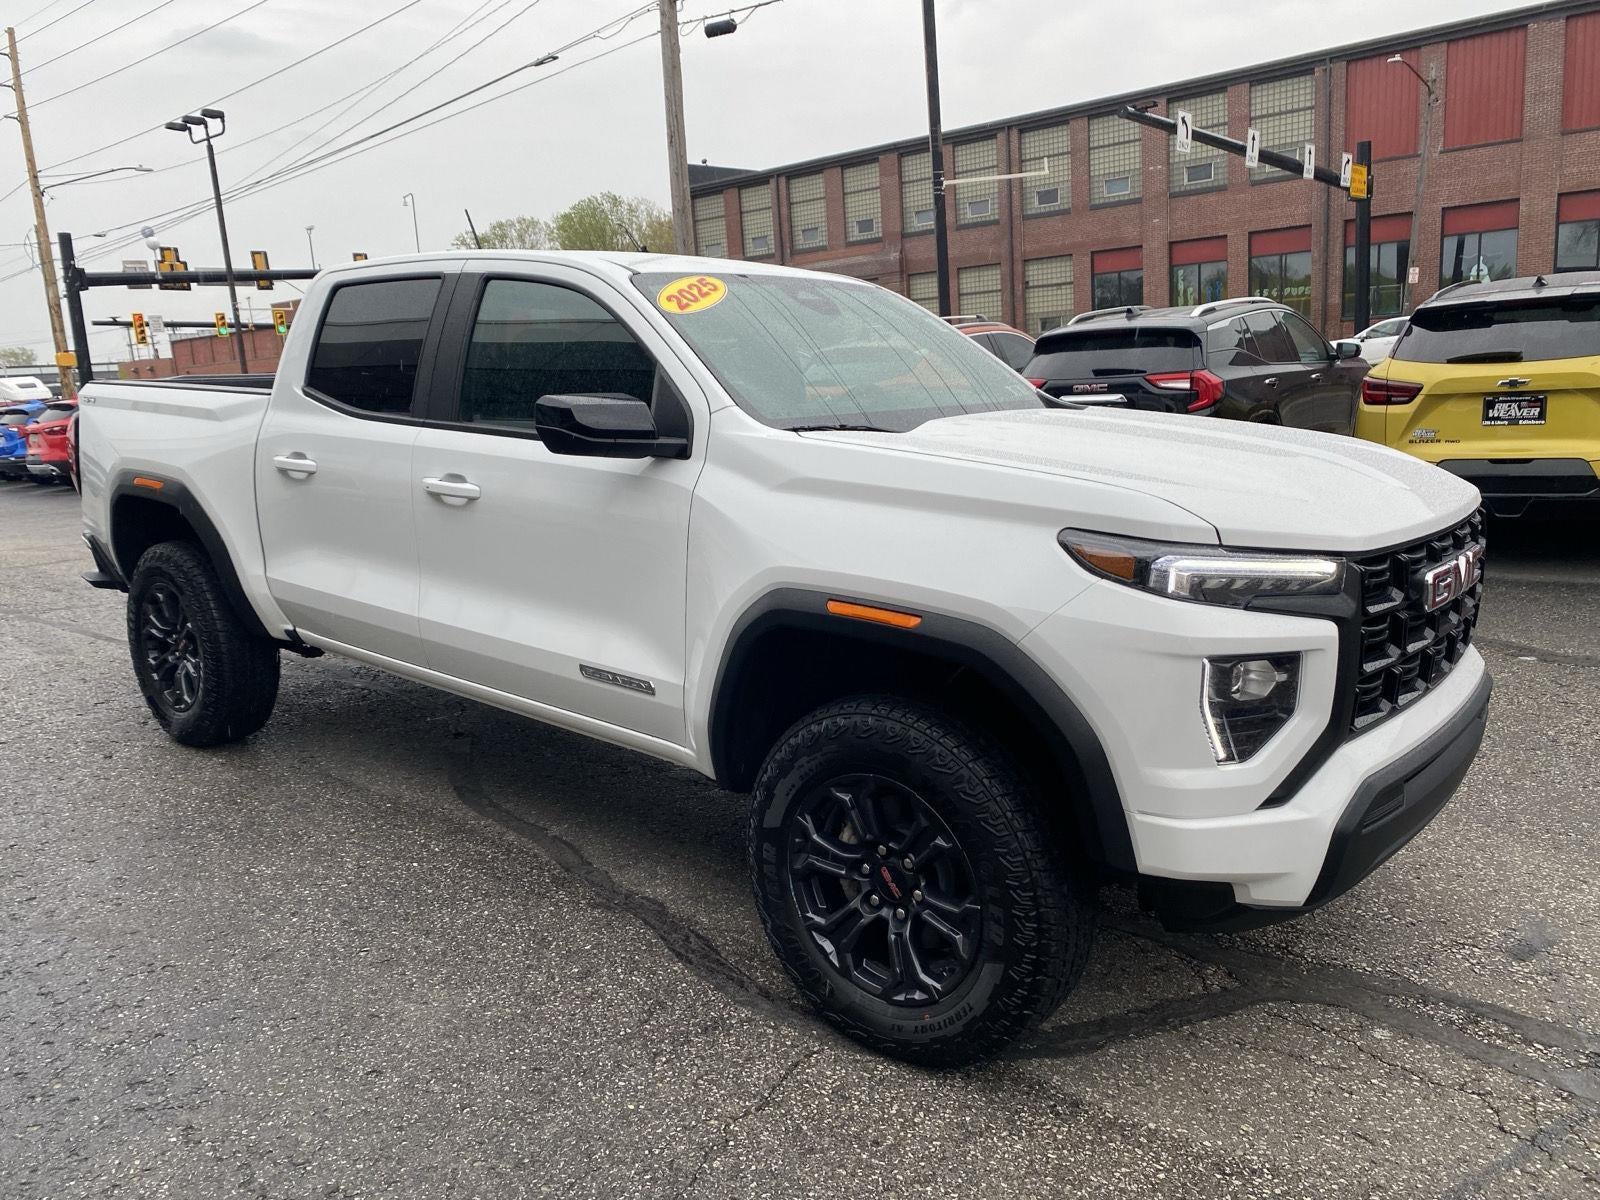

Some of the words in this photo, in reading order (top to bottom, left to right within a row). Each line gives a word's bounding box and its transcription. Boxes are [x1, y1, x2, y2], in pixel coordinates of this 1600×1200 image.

[666, 277, 718, 311] 2025
[1072, 383, 1108, 393] GMC
[1494, 402, 1519, 411] RICK
[1488, 407, 1541, 418] WEAVER
